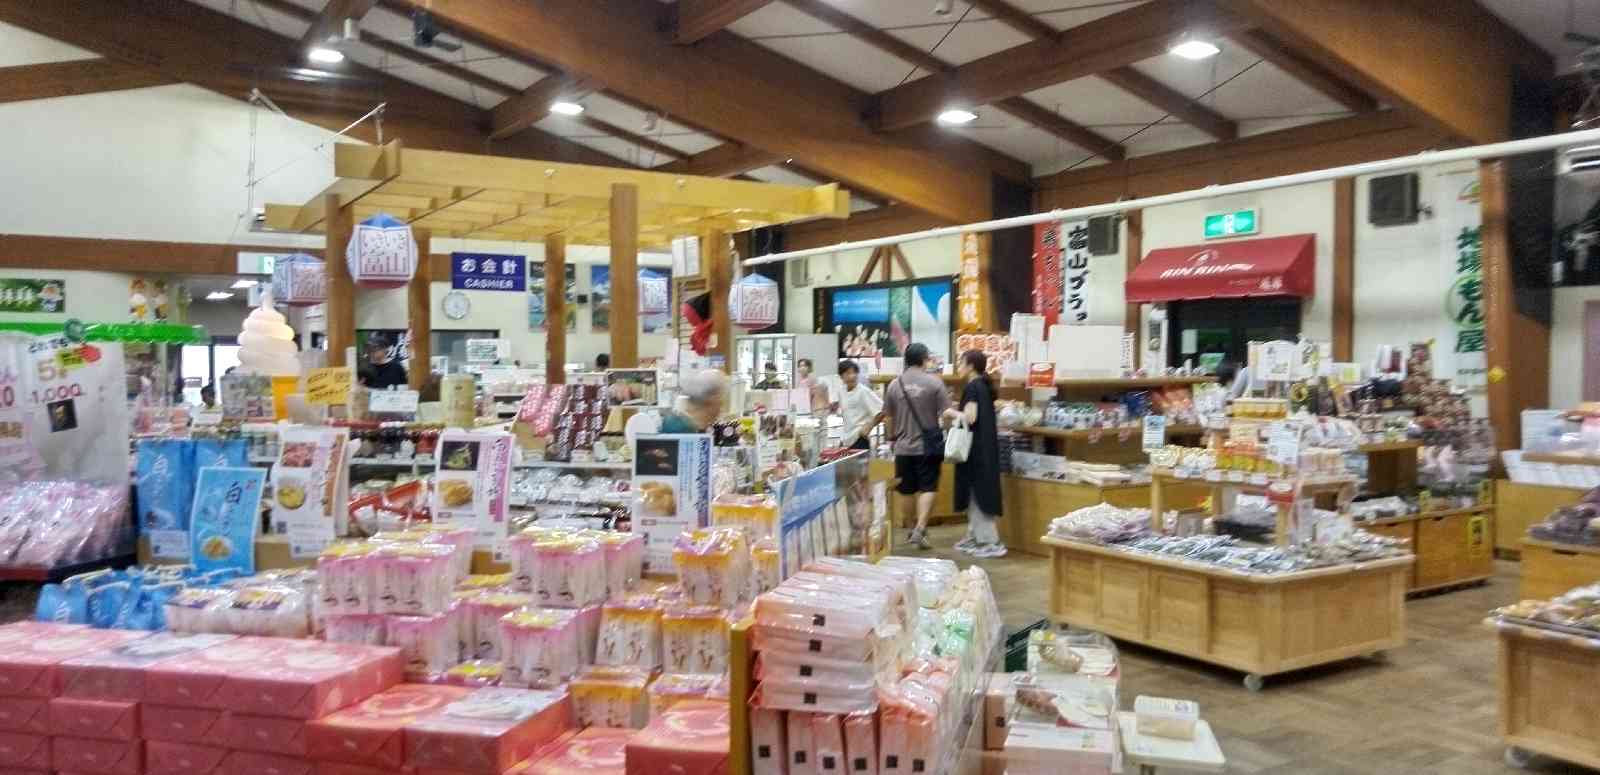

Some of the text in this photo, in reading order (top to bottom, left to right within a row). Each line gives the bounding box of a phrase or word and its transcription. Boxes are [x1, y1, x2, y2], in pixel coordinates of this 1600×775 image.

[461, 258, 518, 275] お会計
[464, 278, 514, 289] CASHIER
